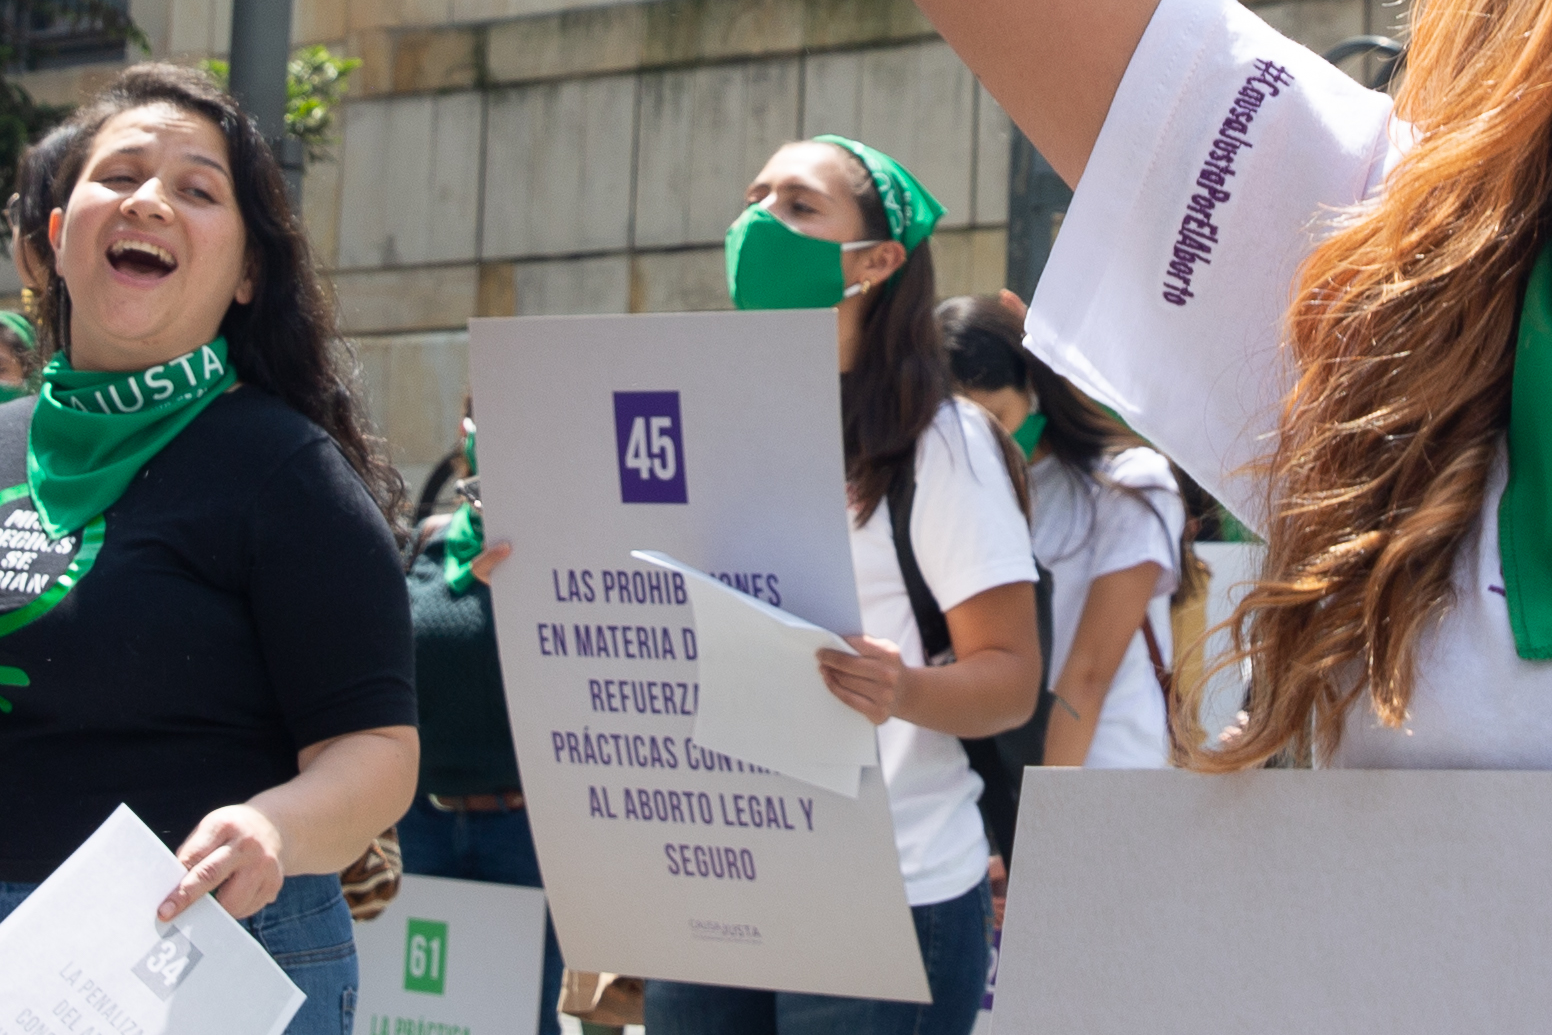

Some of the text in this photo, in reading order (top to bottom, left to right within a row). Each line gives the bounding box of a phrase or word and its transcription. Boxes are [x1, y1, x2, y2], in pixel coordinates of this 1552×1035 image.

[1163, 57, 1295, 307] #CausaJustaPorElAborto
[625, 416, 677, 481] 45
[552, 569, 596, 603] LAS
[537, 622, 699, 661] EN MATERIA D
[552, 725, 678, 769] PRÁCTICAS
[588, 785, 814, 832] AL ABORTO LEGAL Y
[664, 843, 757, 882] SEGURO
[146, 940, 191, 987] 34
[410, 934, 441, 981] 61
[52, 999, 83, 1032] DEL
[58, 960, 145, 1035] LA PENALIZ
